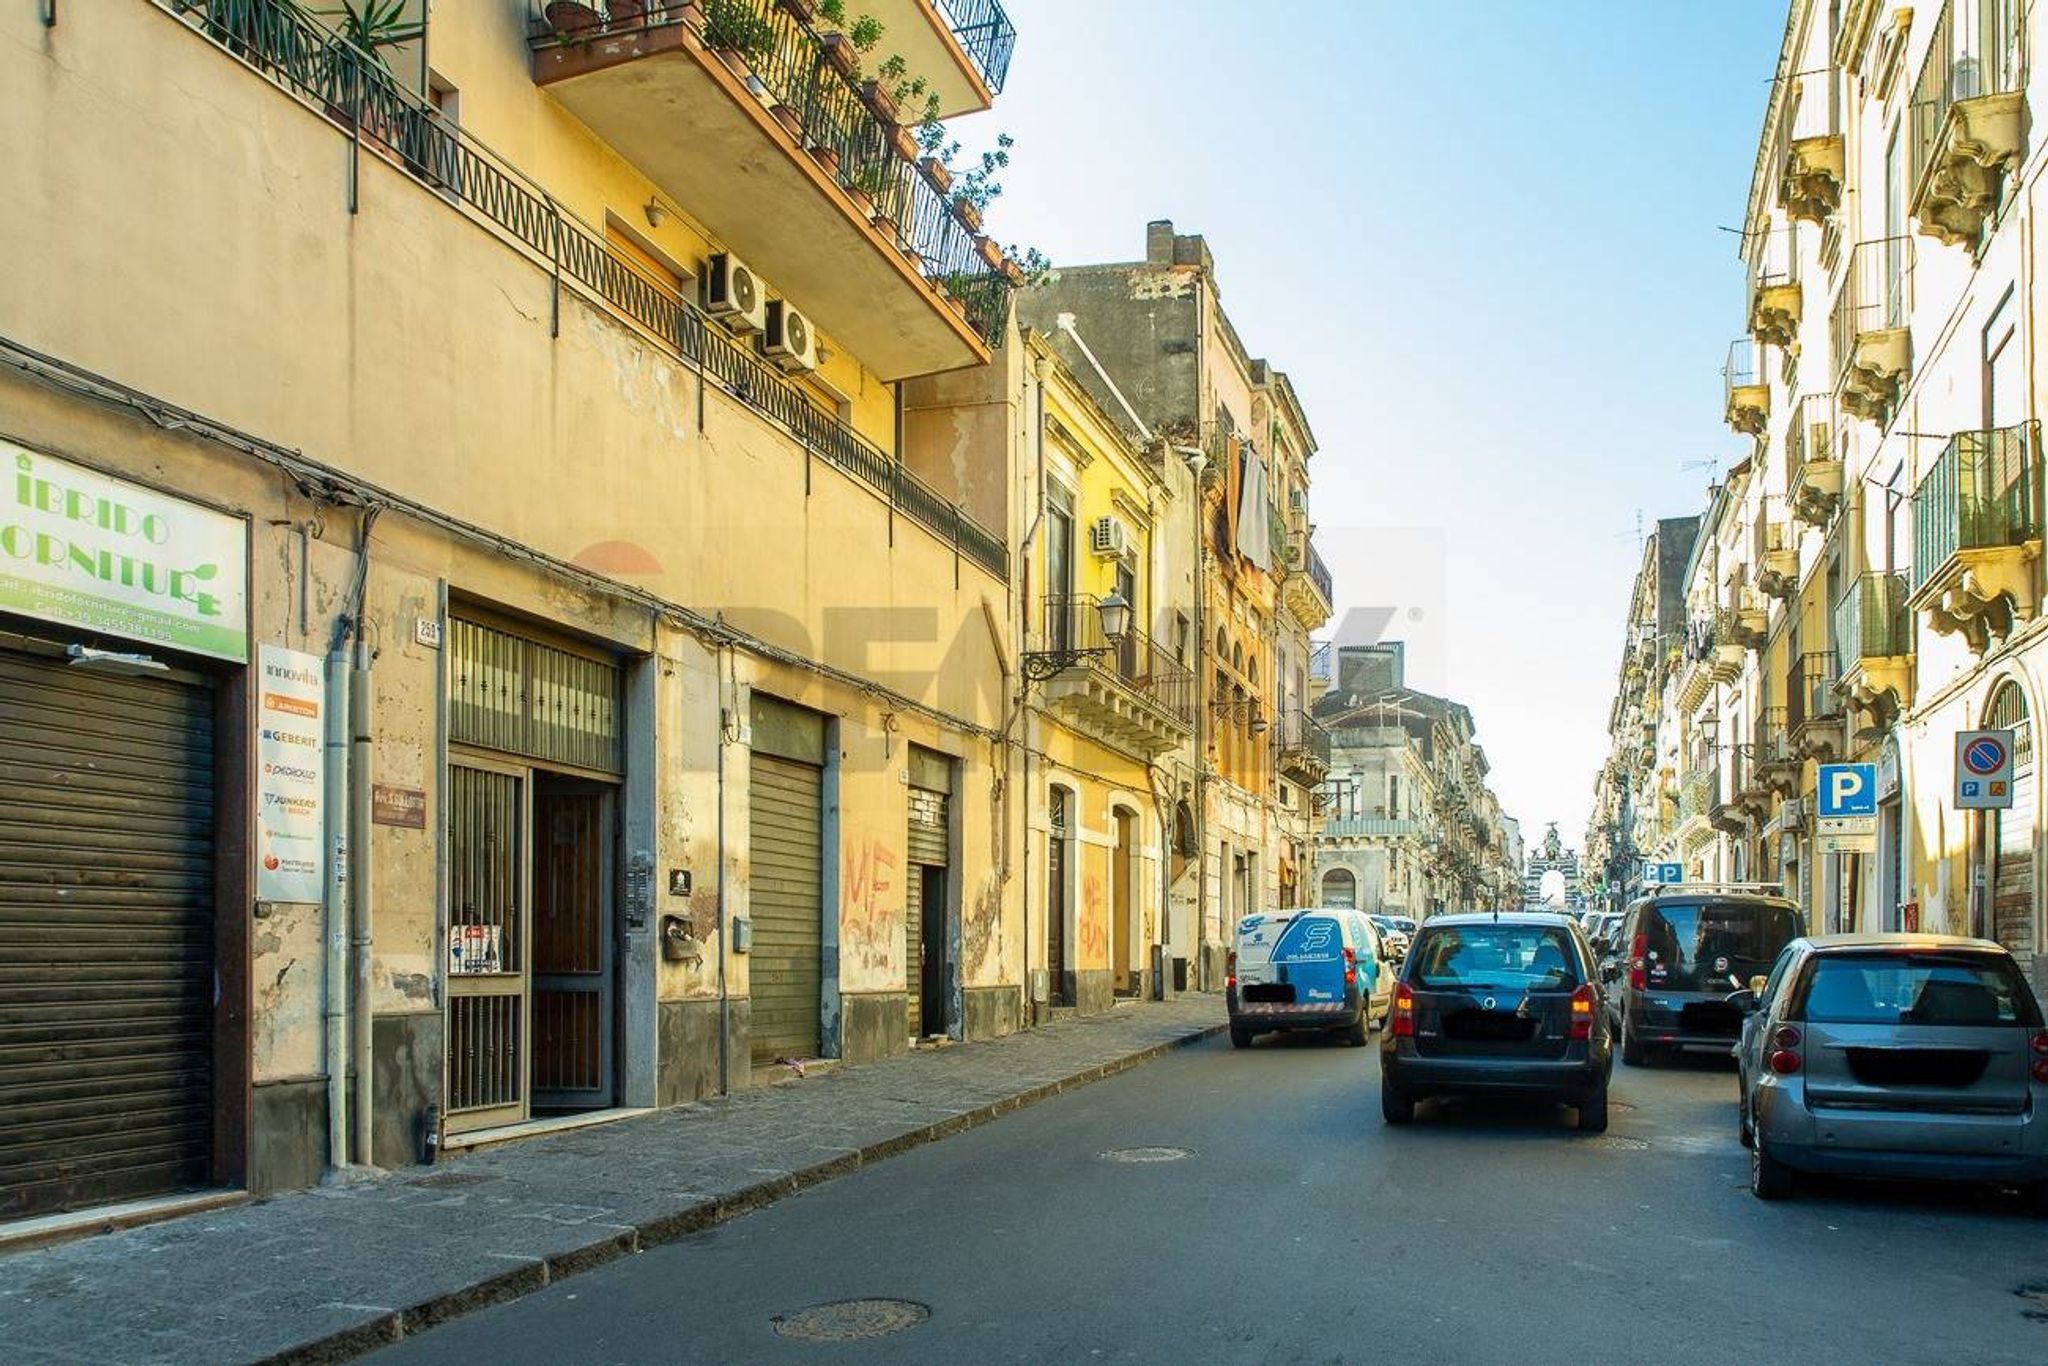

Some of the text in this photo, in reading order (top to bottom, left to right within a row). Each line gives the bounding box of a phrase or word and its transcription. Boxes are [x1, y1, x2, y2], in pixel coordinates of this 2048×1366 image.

[266, 661, 318, 686] innovita
[272, 731, 317, 748] GEBERIT
[1832, 772, 1863, 809] P
[1965, 784, 1976, 796] P
[275, 795, 316, 808] JUNKERS
[1663, 866, 1677, 883] P
